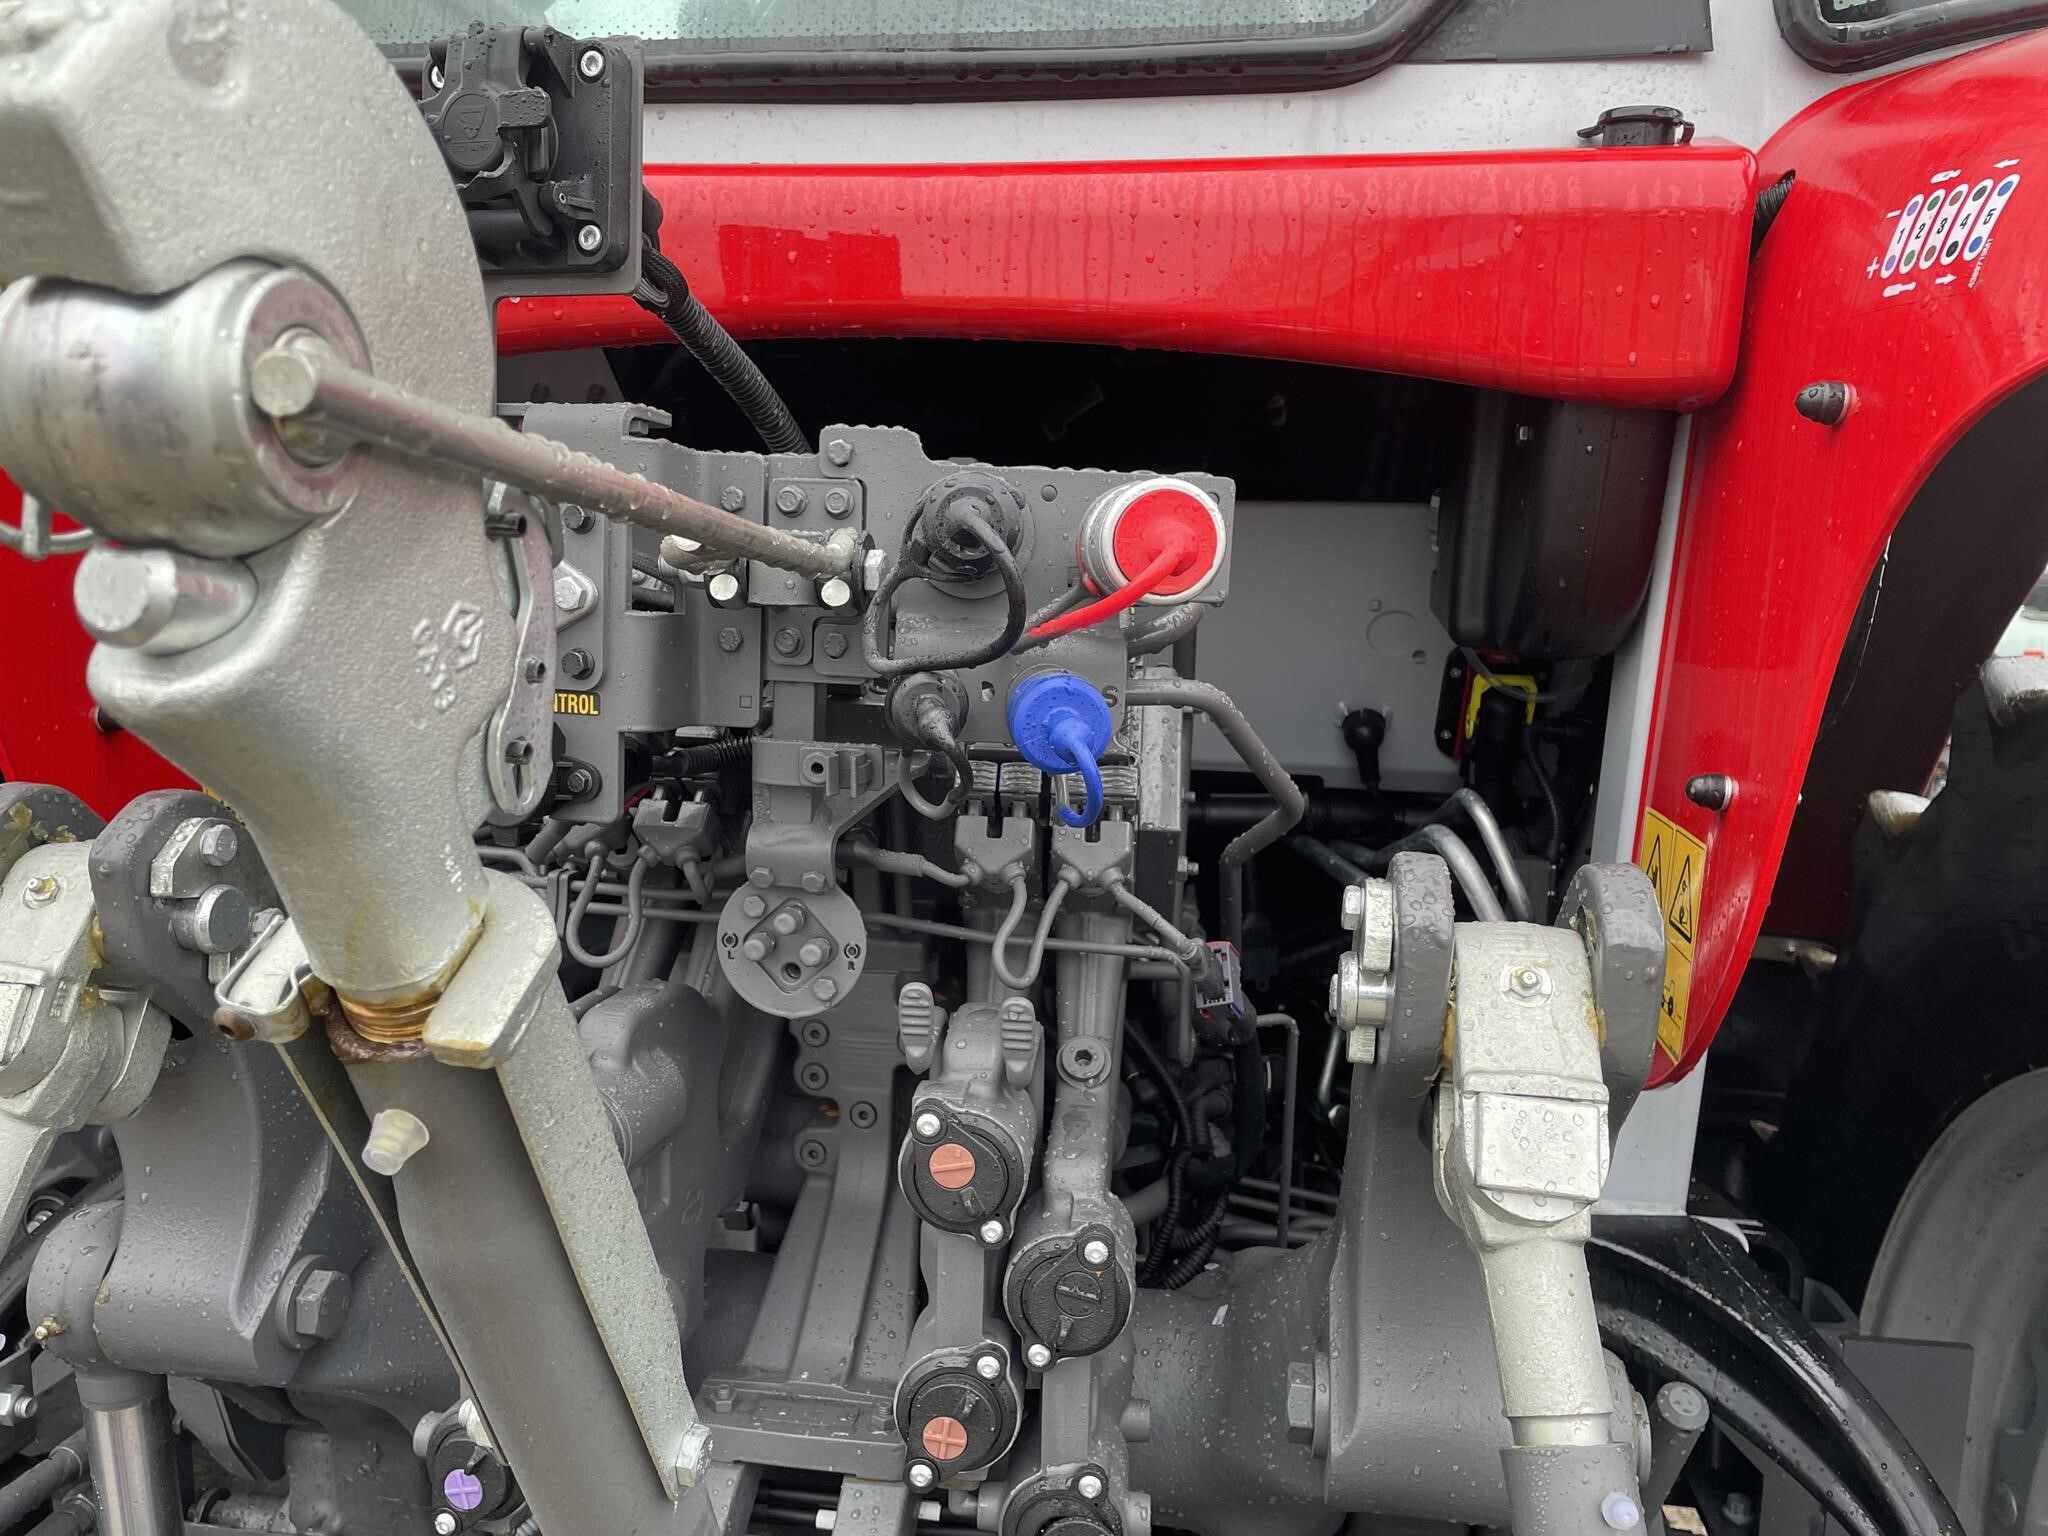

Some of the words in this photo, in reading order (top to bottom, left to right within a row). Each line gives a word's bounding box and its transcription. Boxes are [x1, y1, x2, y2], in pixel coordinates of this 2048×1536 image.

[1959, 212, 1972, 230] 4
[1982, 207, 1997, 226] 5
[1914, 222, 1927, 241] 2
[1936, 217, 1949, 235] 3
[1896, 227, 1906, 245] 1
[727, 950, 735, 960] L
[847, 960, 856, 971] R
